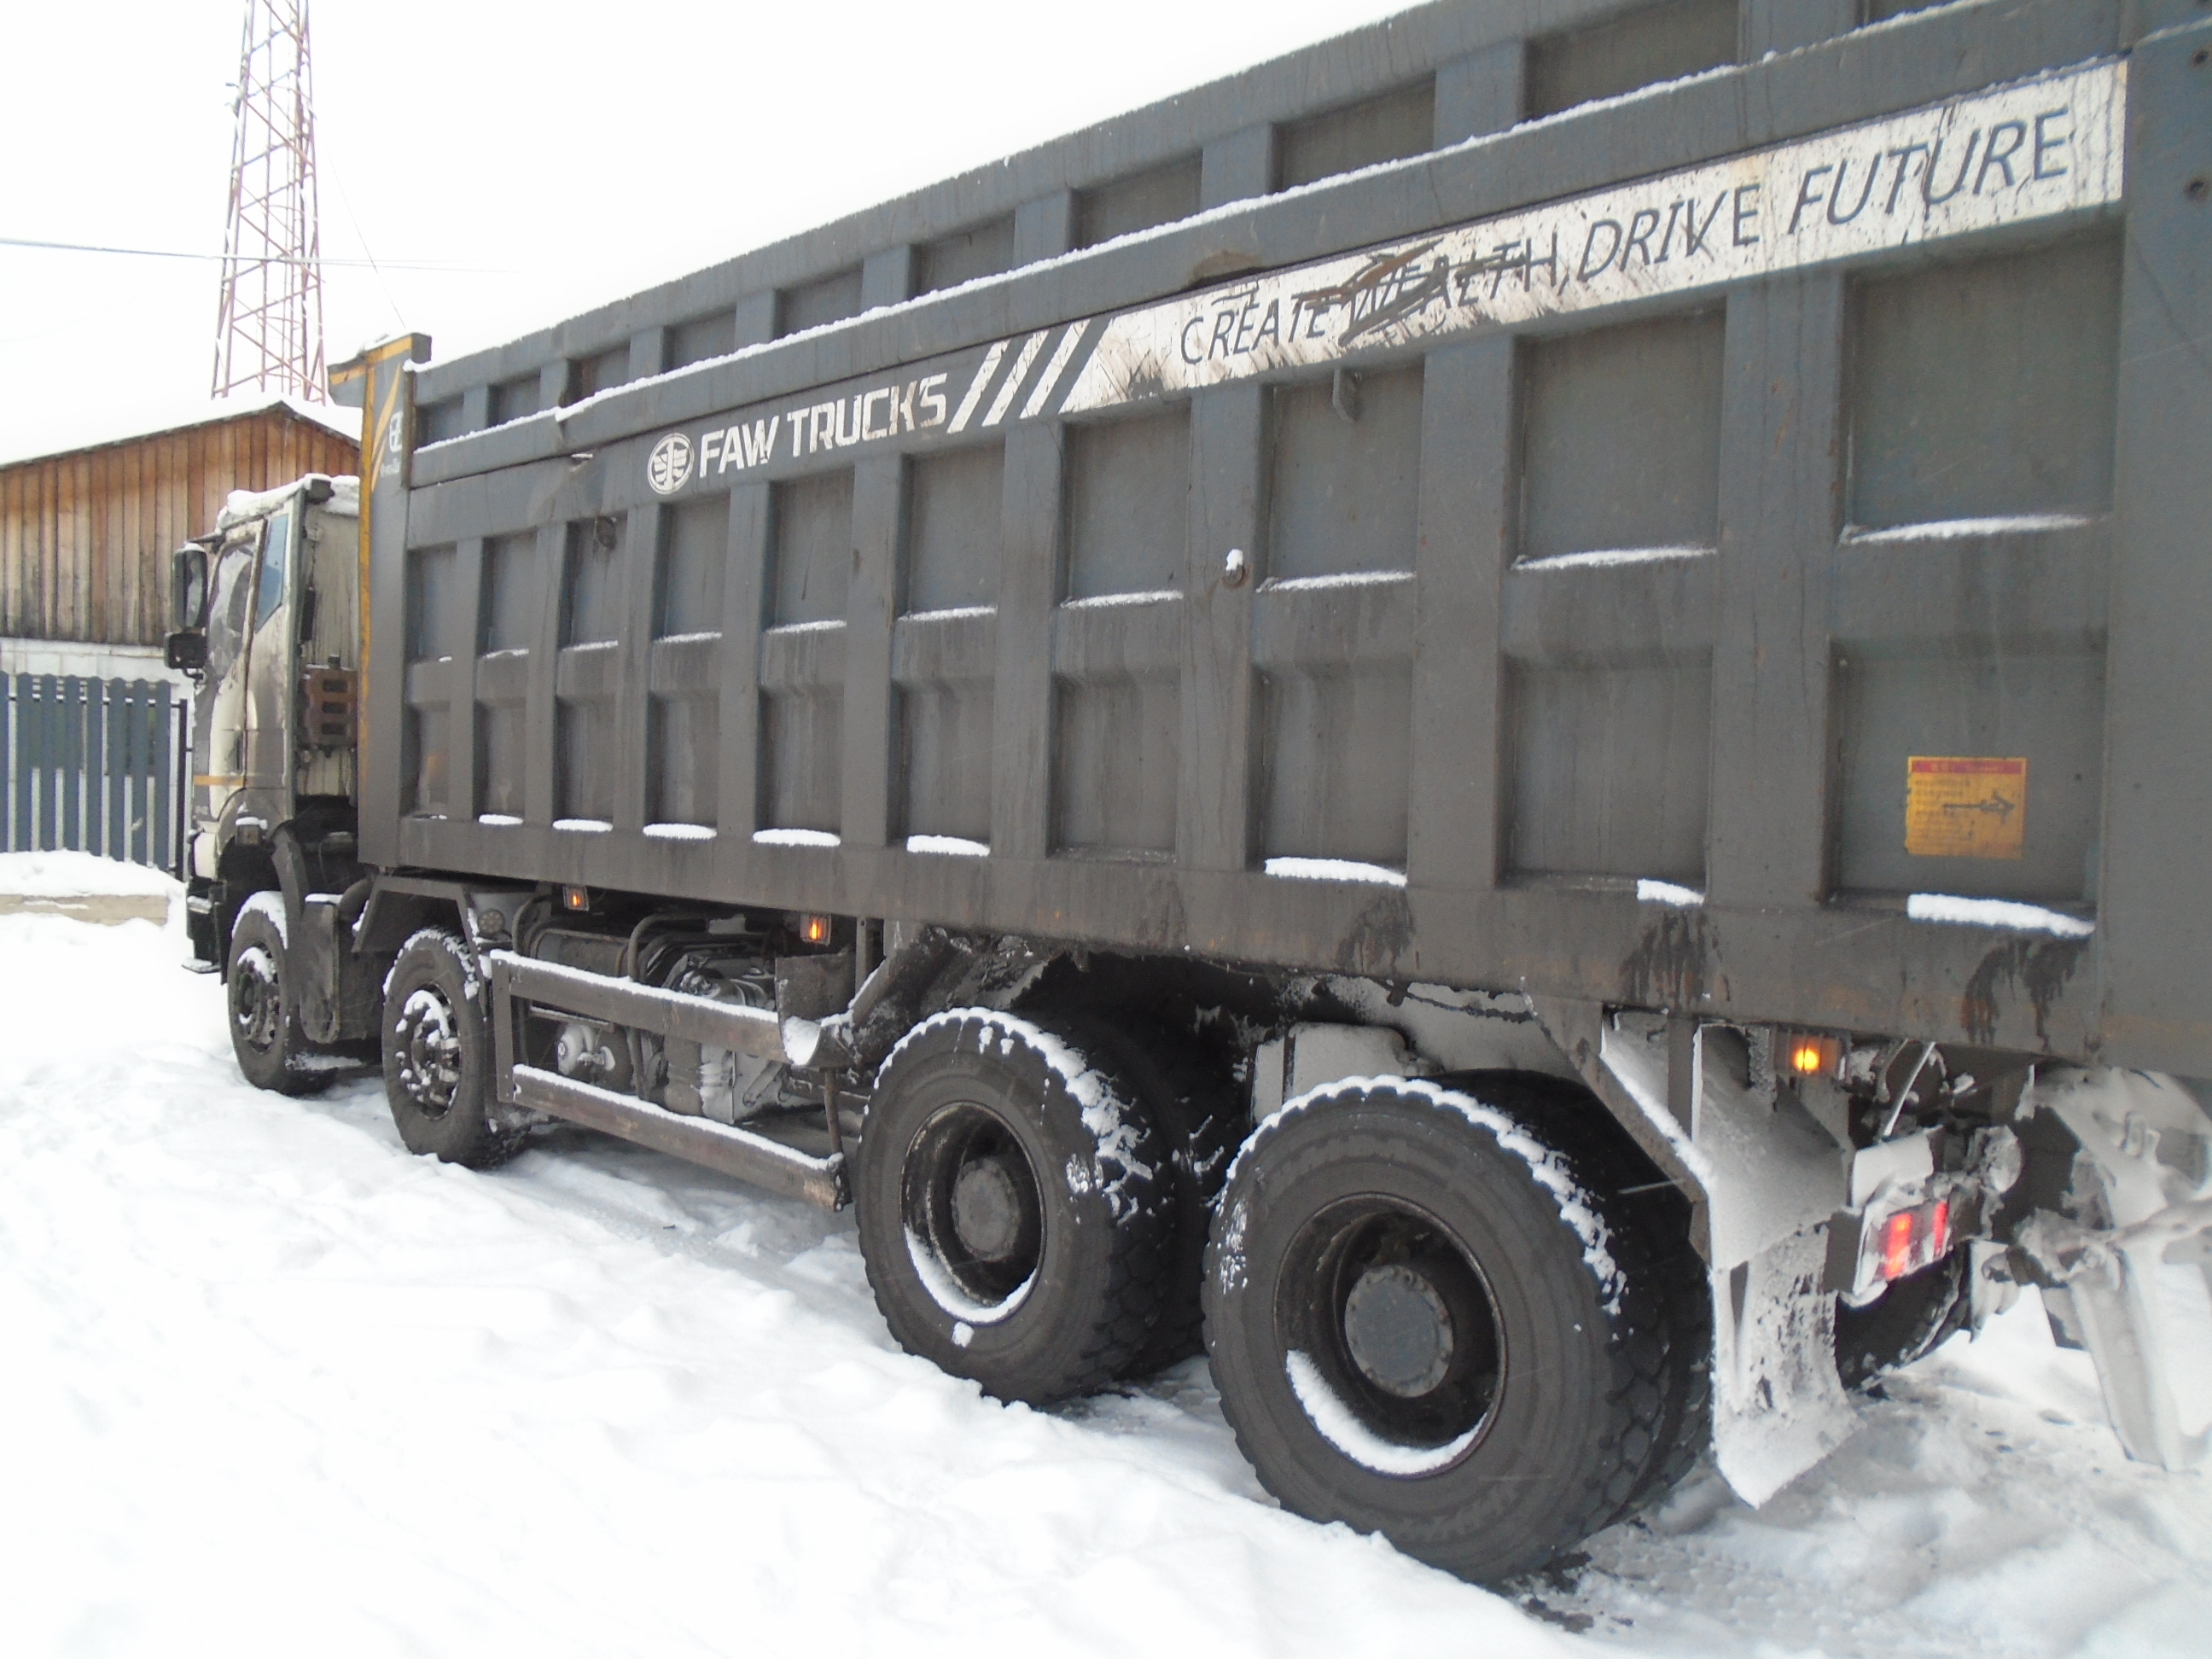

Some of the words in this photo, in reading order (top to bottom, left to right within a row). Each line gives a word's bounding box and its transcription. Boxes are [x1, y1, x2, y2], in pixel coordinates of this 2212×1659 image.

[1576, 183, 1761, 282] DRIVE
[1790, 107, 2069, 235] FUTURE
[698, 415, 779, 479] FAW
[786, 372, 948, 457] TRUCKS
